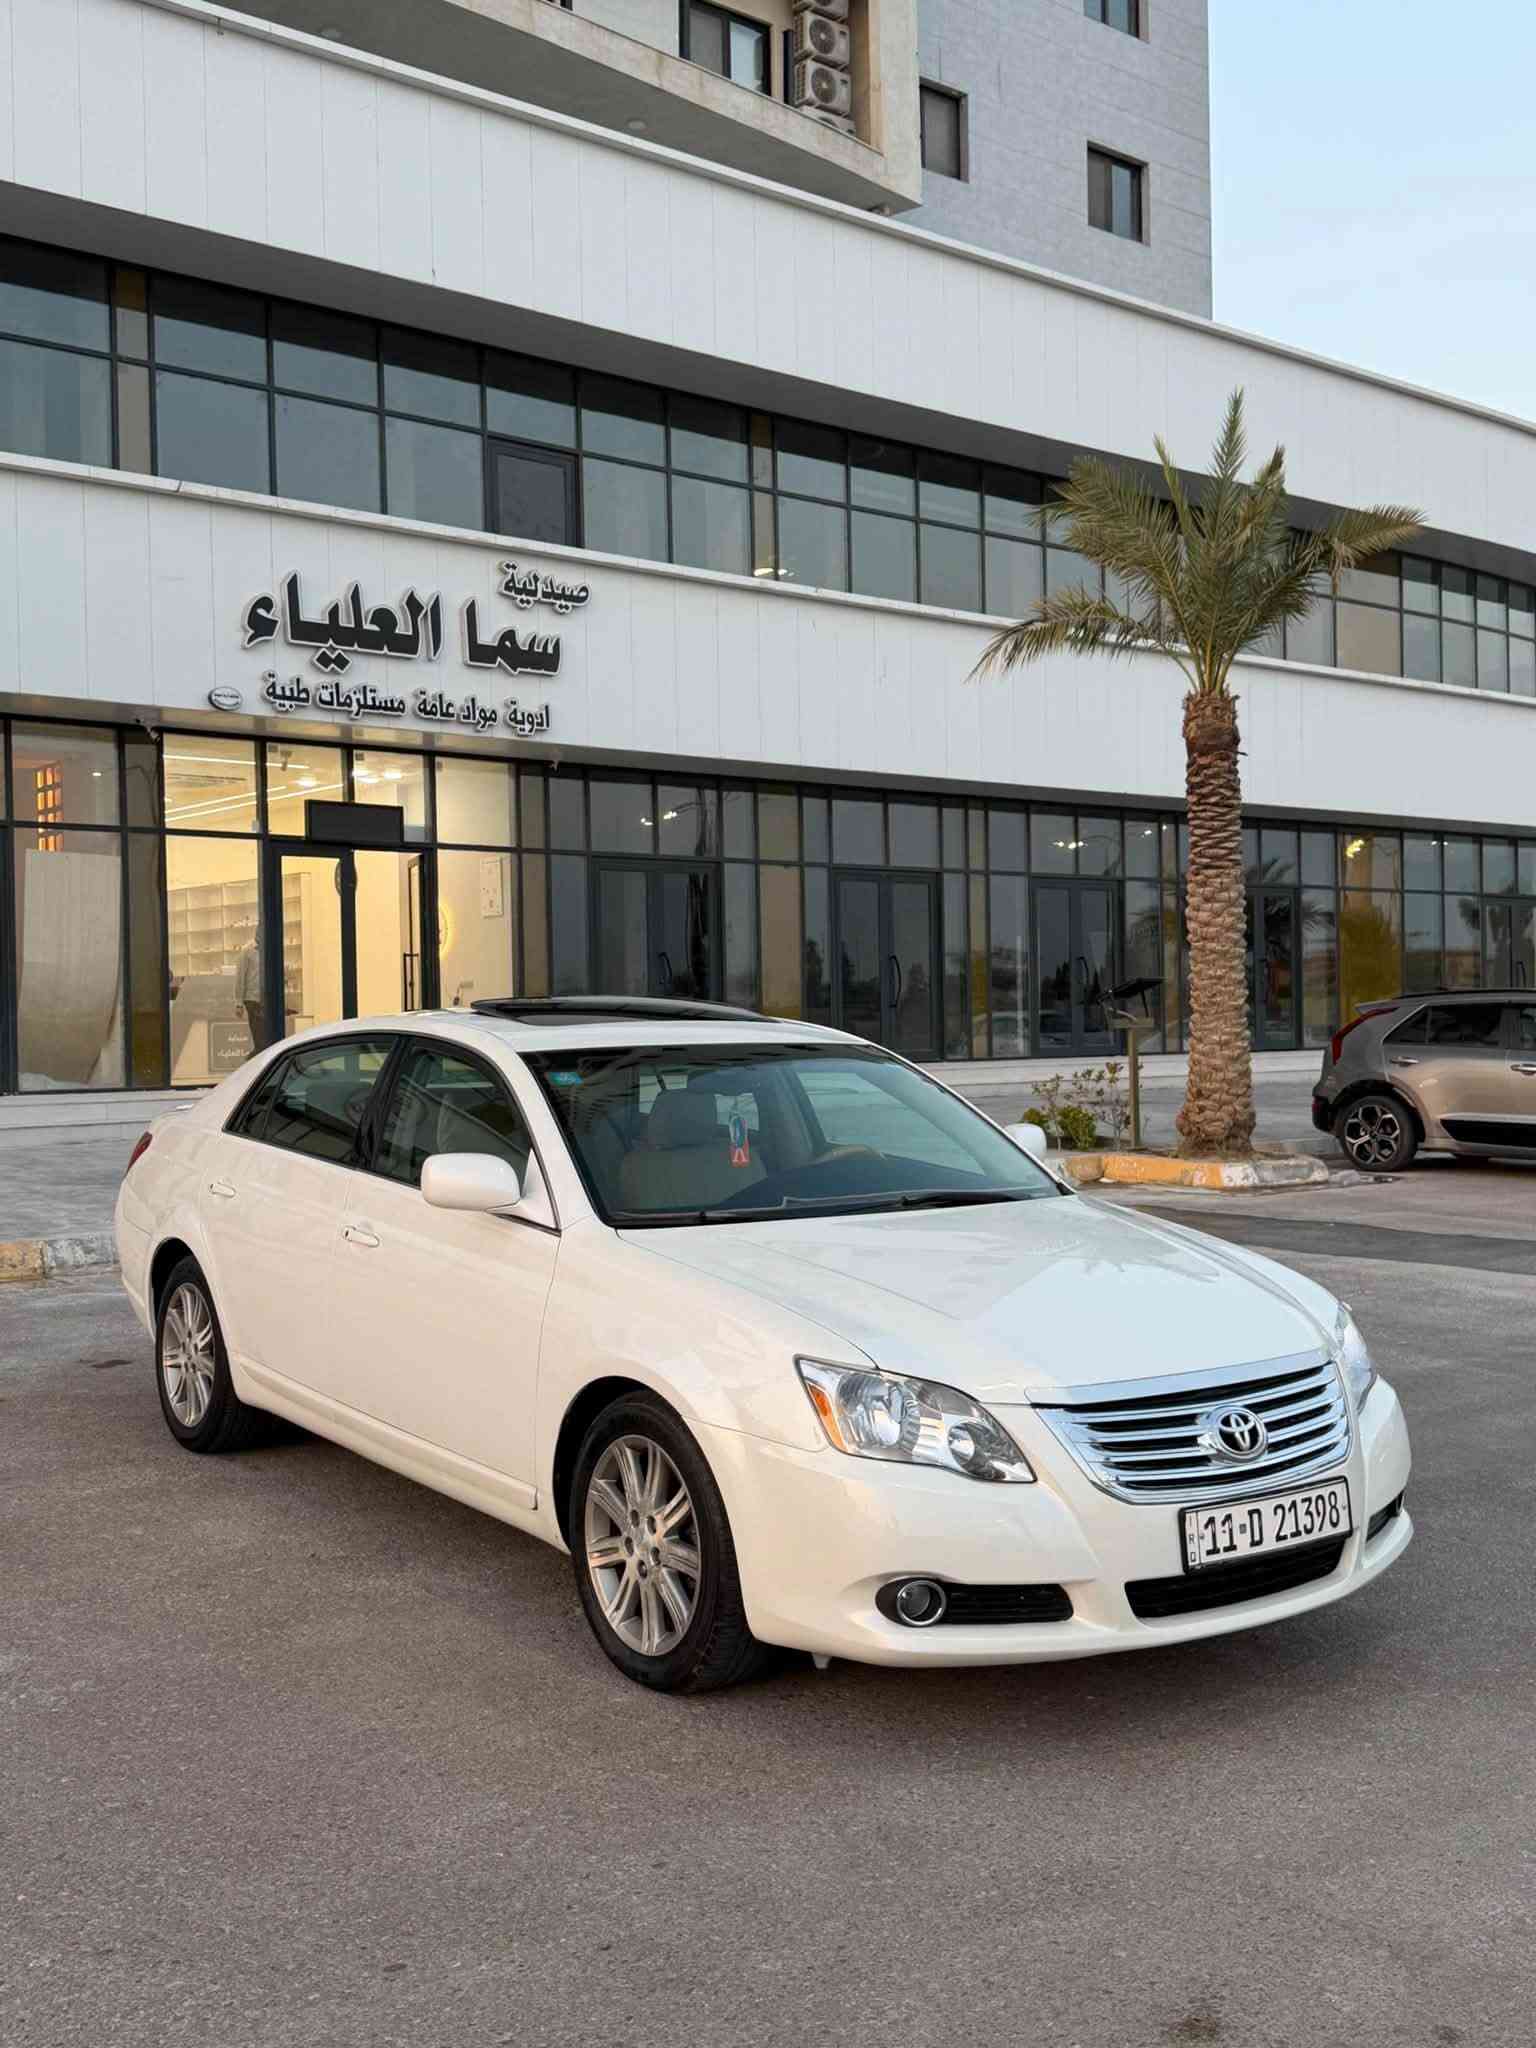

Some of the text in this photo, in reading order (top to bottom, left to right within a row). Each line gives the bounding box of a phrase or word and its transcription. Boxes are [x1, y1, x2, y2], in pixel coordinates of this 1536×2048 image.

[501, 561, 589, 612] صيدلية
[243, 569, 562, 675] سما العلياء
[264, 670, 551, 735] ادوية مواد عامة مستلزمات طبية
[1203, 1491, 1340, 1556] 11 D 21398
